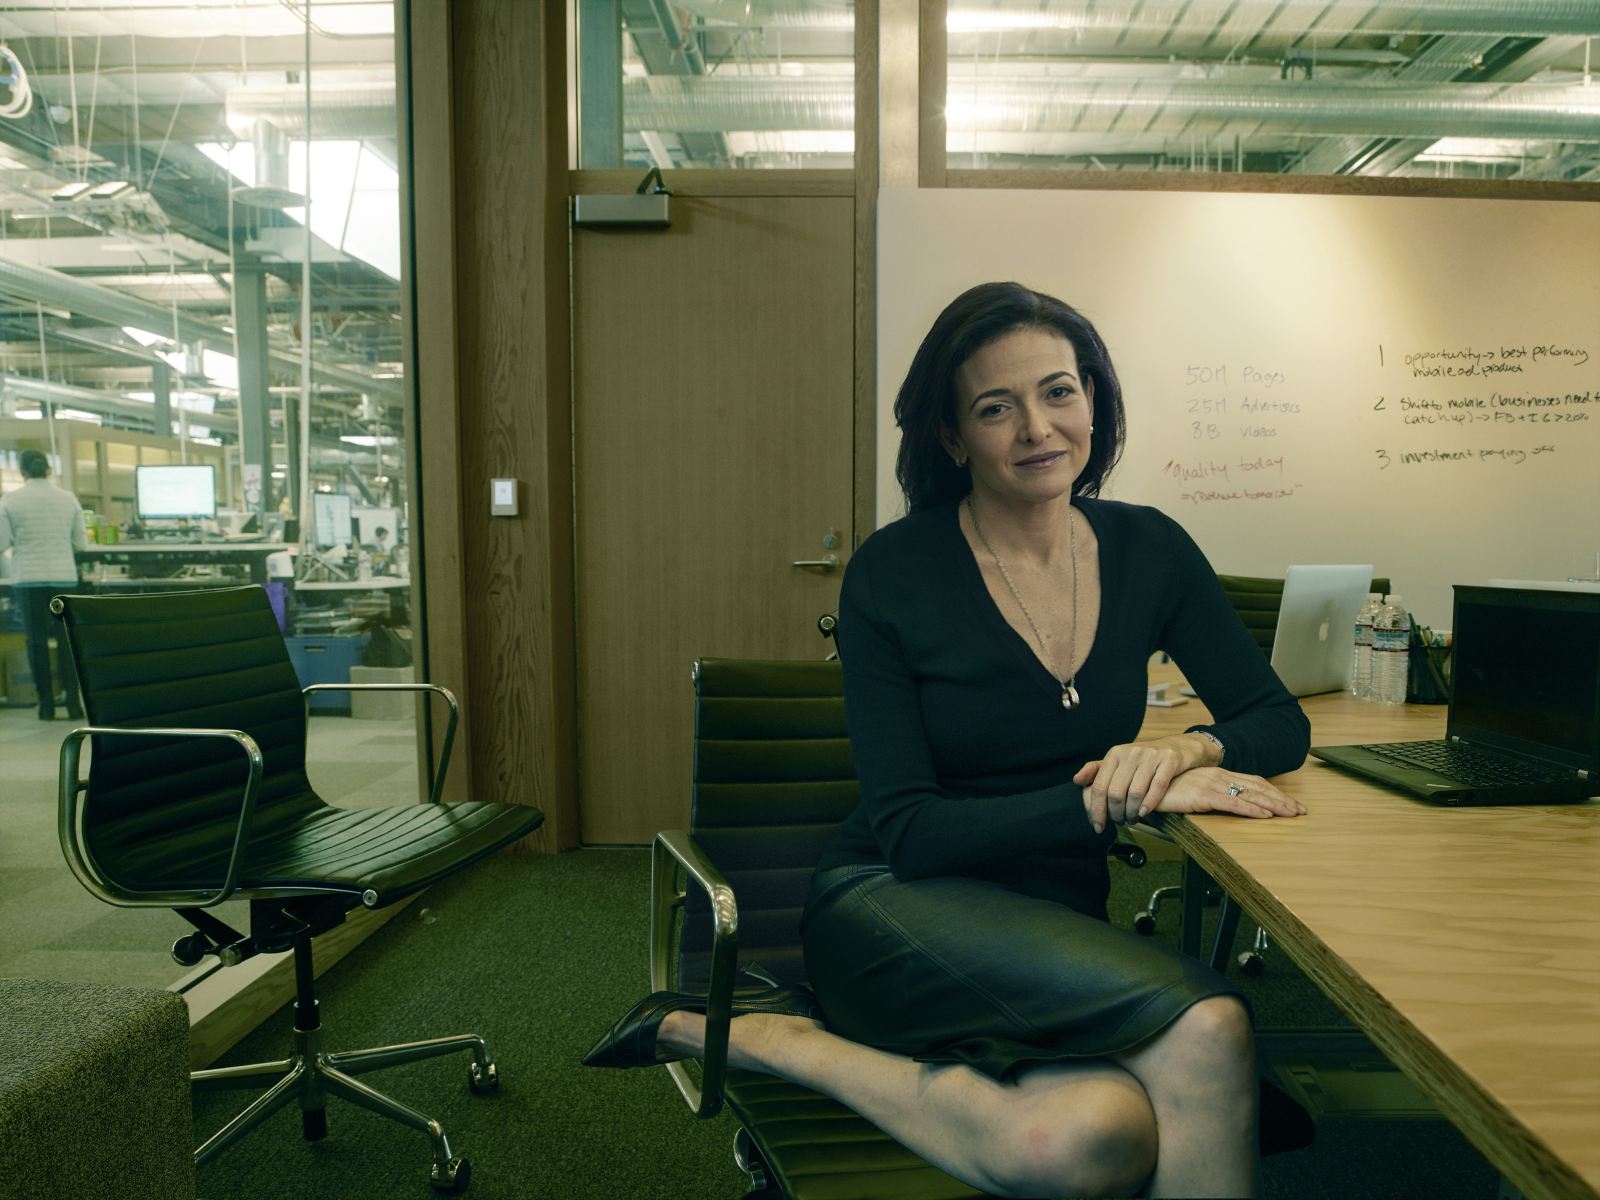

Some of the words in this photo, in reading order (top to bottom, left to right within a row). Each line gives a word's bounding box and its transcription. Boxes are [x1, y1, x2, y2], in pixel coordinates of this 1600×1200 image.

[1404, 346, 1481, 369] opportunity
[1500, 345, 1527, 360] best
[1185, 364, 1229, 386] 50M
[1243, 365, 1286, 389] Pages
[1373, 397, 1386, 411] 2
[1564, 391, 1593, 406] need
[1238, 456, 1284, 477] today
[1375, 449, 1391, 470] 3
[1400, 448, 1473, 465] investment
[1479, 447, 1527, 465] paying
